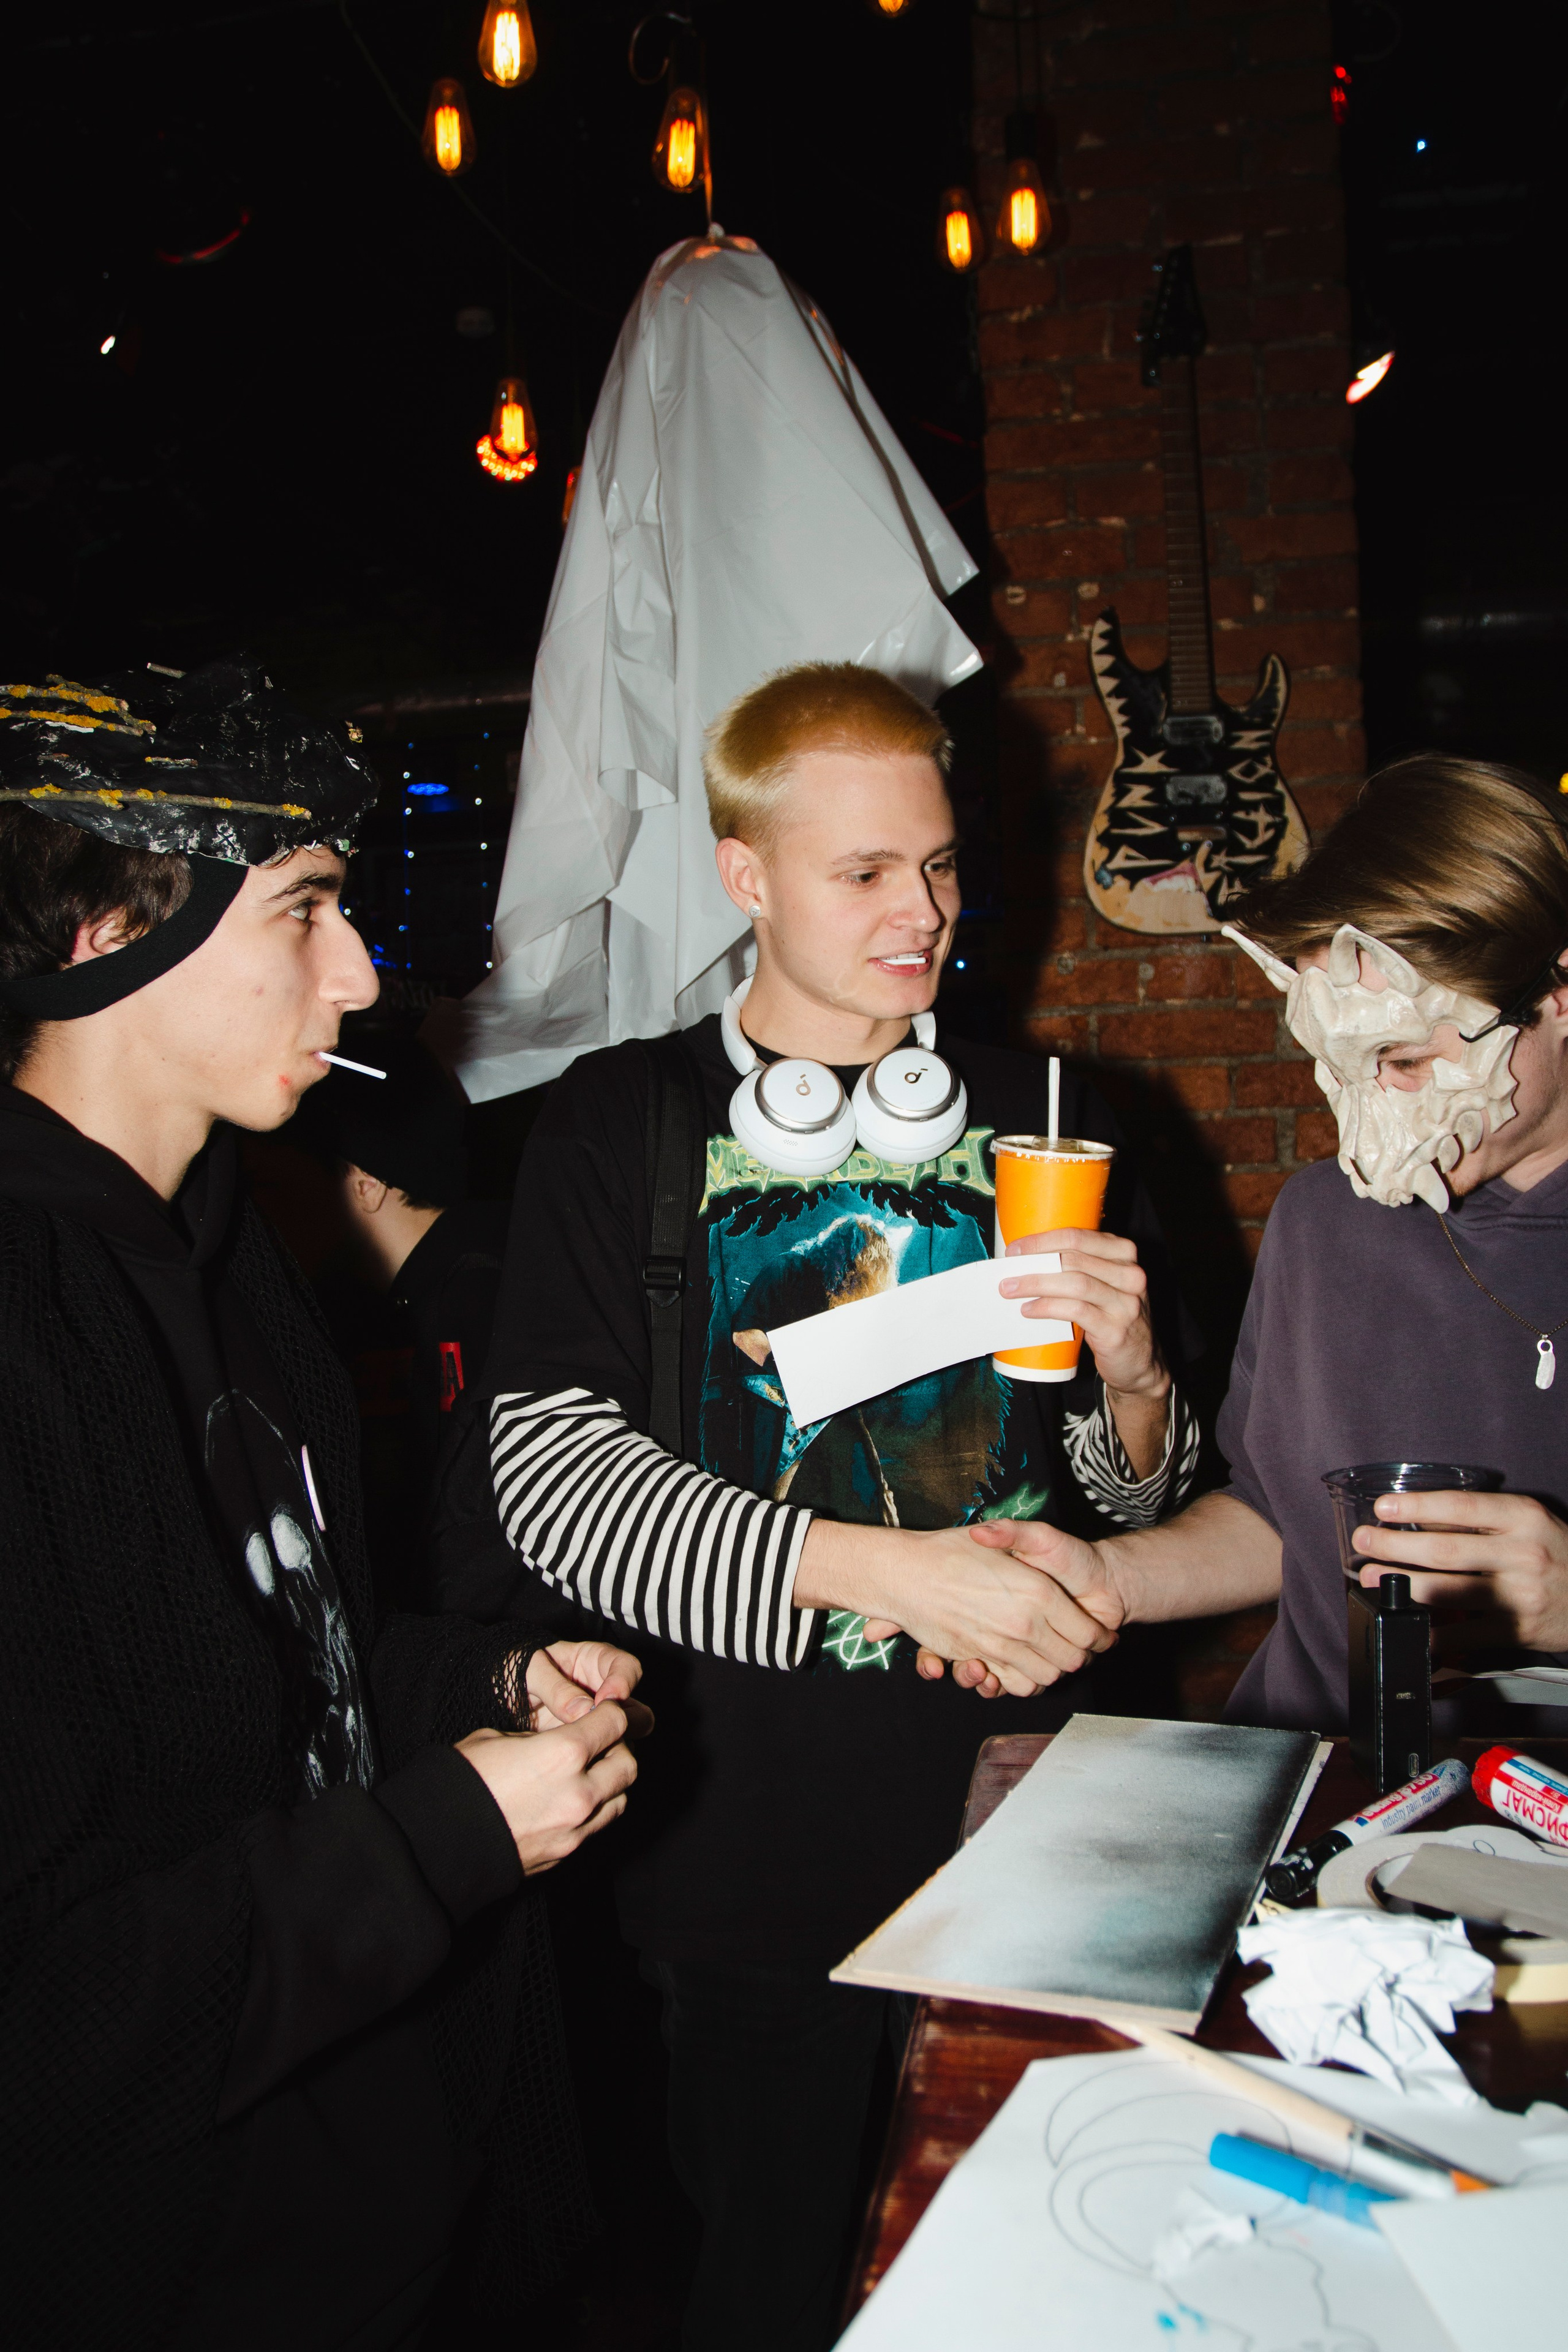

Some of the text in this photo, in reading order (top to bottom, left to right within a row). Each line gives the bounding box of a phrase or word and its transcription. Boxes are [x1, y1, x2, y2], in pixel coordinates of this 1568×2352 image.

[698, 1129, 995, 1215] MEDEH
[1362, 1792, 1403, 1817] eding
[1512, 1779, 1561, 1812] Клей-карандаш
[1381, 1806, 1406, 1830] industry
